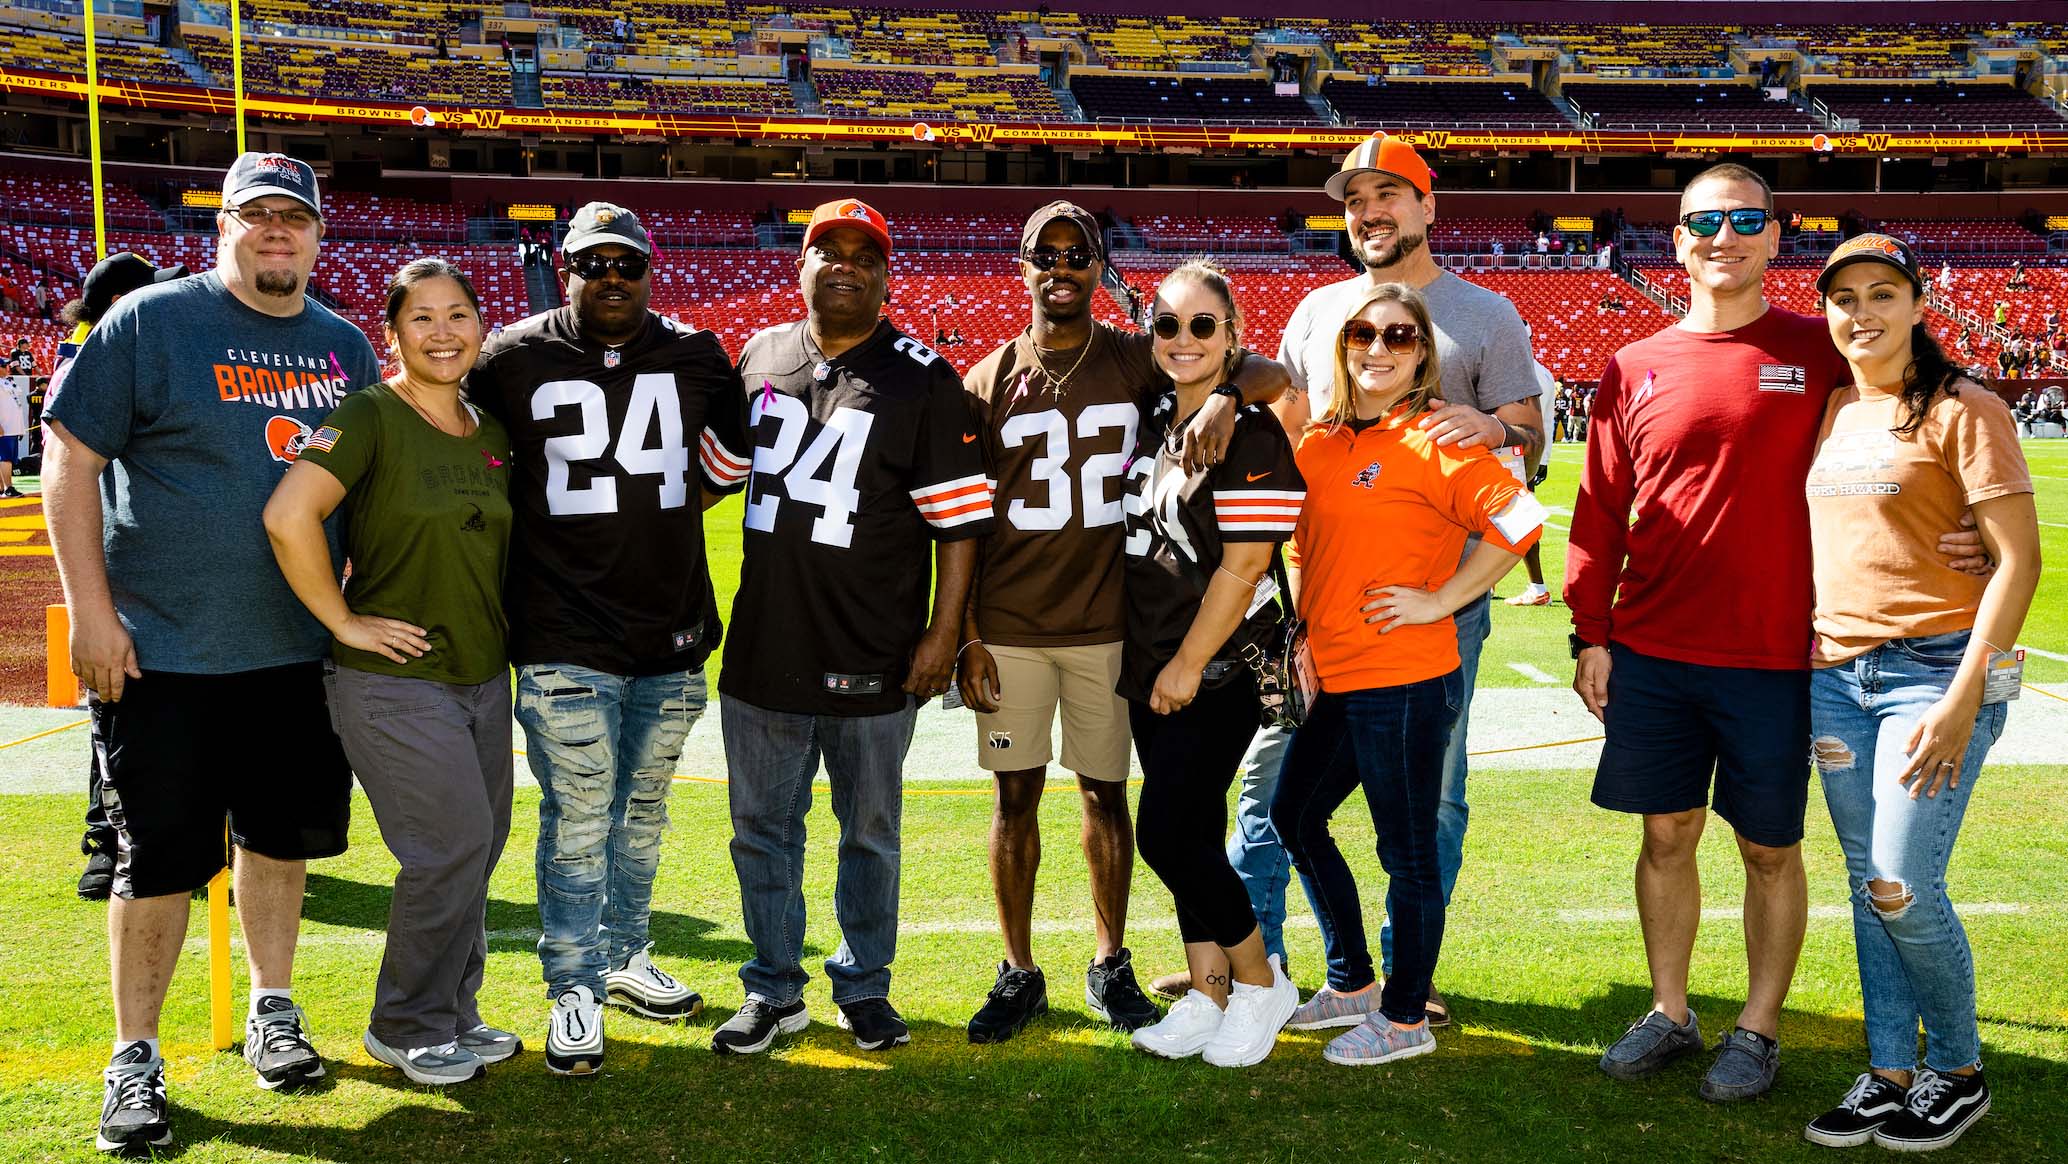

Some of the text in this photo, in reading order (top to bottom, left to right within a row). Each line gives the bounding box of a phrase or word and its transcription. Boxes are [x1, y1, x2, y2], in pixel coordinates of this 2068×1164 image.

[487, 21, 503, 29] 337
[337, 108, 402, 118] BROWNS
[442, 113, 464, 123] VS
[511, 116, 610, 126] COMMANDERS
[848, 126, 905, 135] BROWNS
[942, 128, 961, 137] VS
[1003, 130, 1092, 138] COMMANDERS
[1399, 135, 1416, 143] VS
[1839, 138, 1857, 147] VS
[508, 209, 557, 218] COMMANDERS
[19, 355, 32, 370] 85
[226, 348, 328, 370] CLEVELAND
[213, 363, 348, 410] BROWNS
[31, 395, 43, 404] FIT
[530, 373, 689, 516] 24
[745, 392, 875, 549] 24
[1000, 402, 1140, 531] 32
